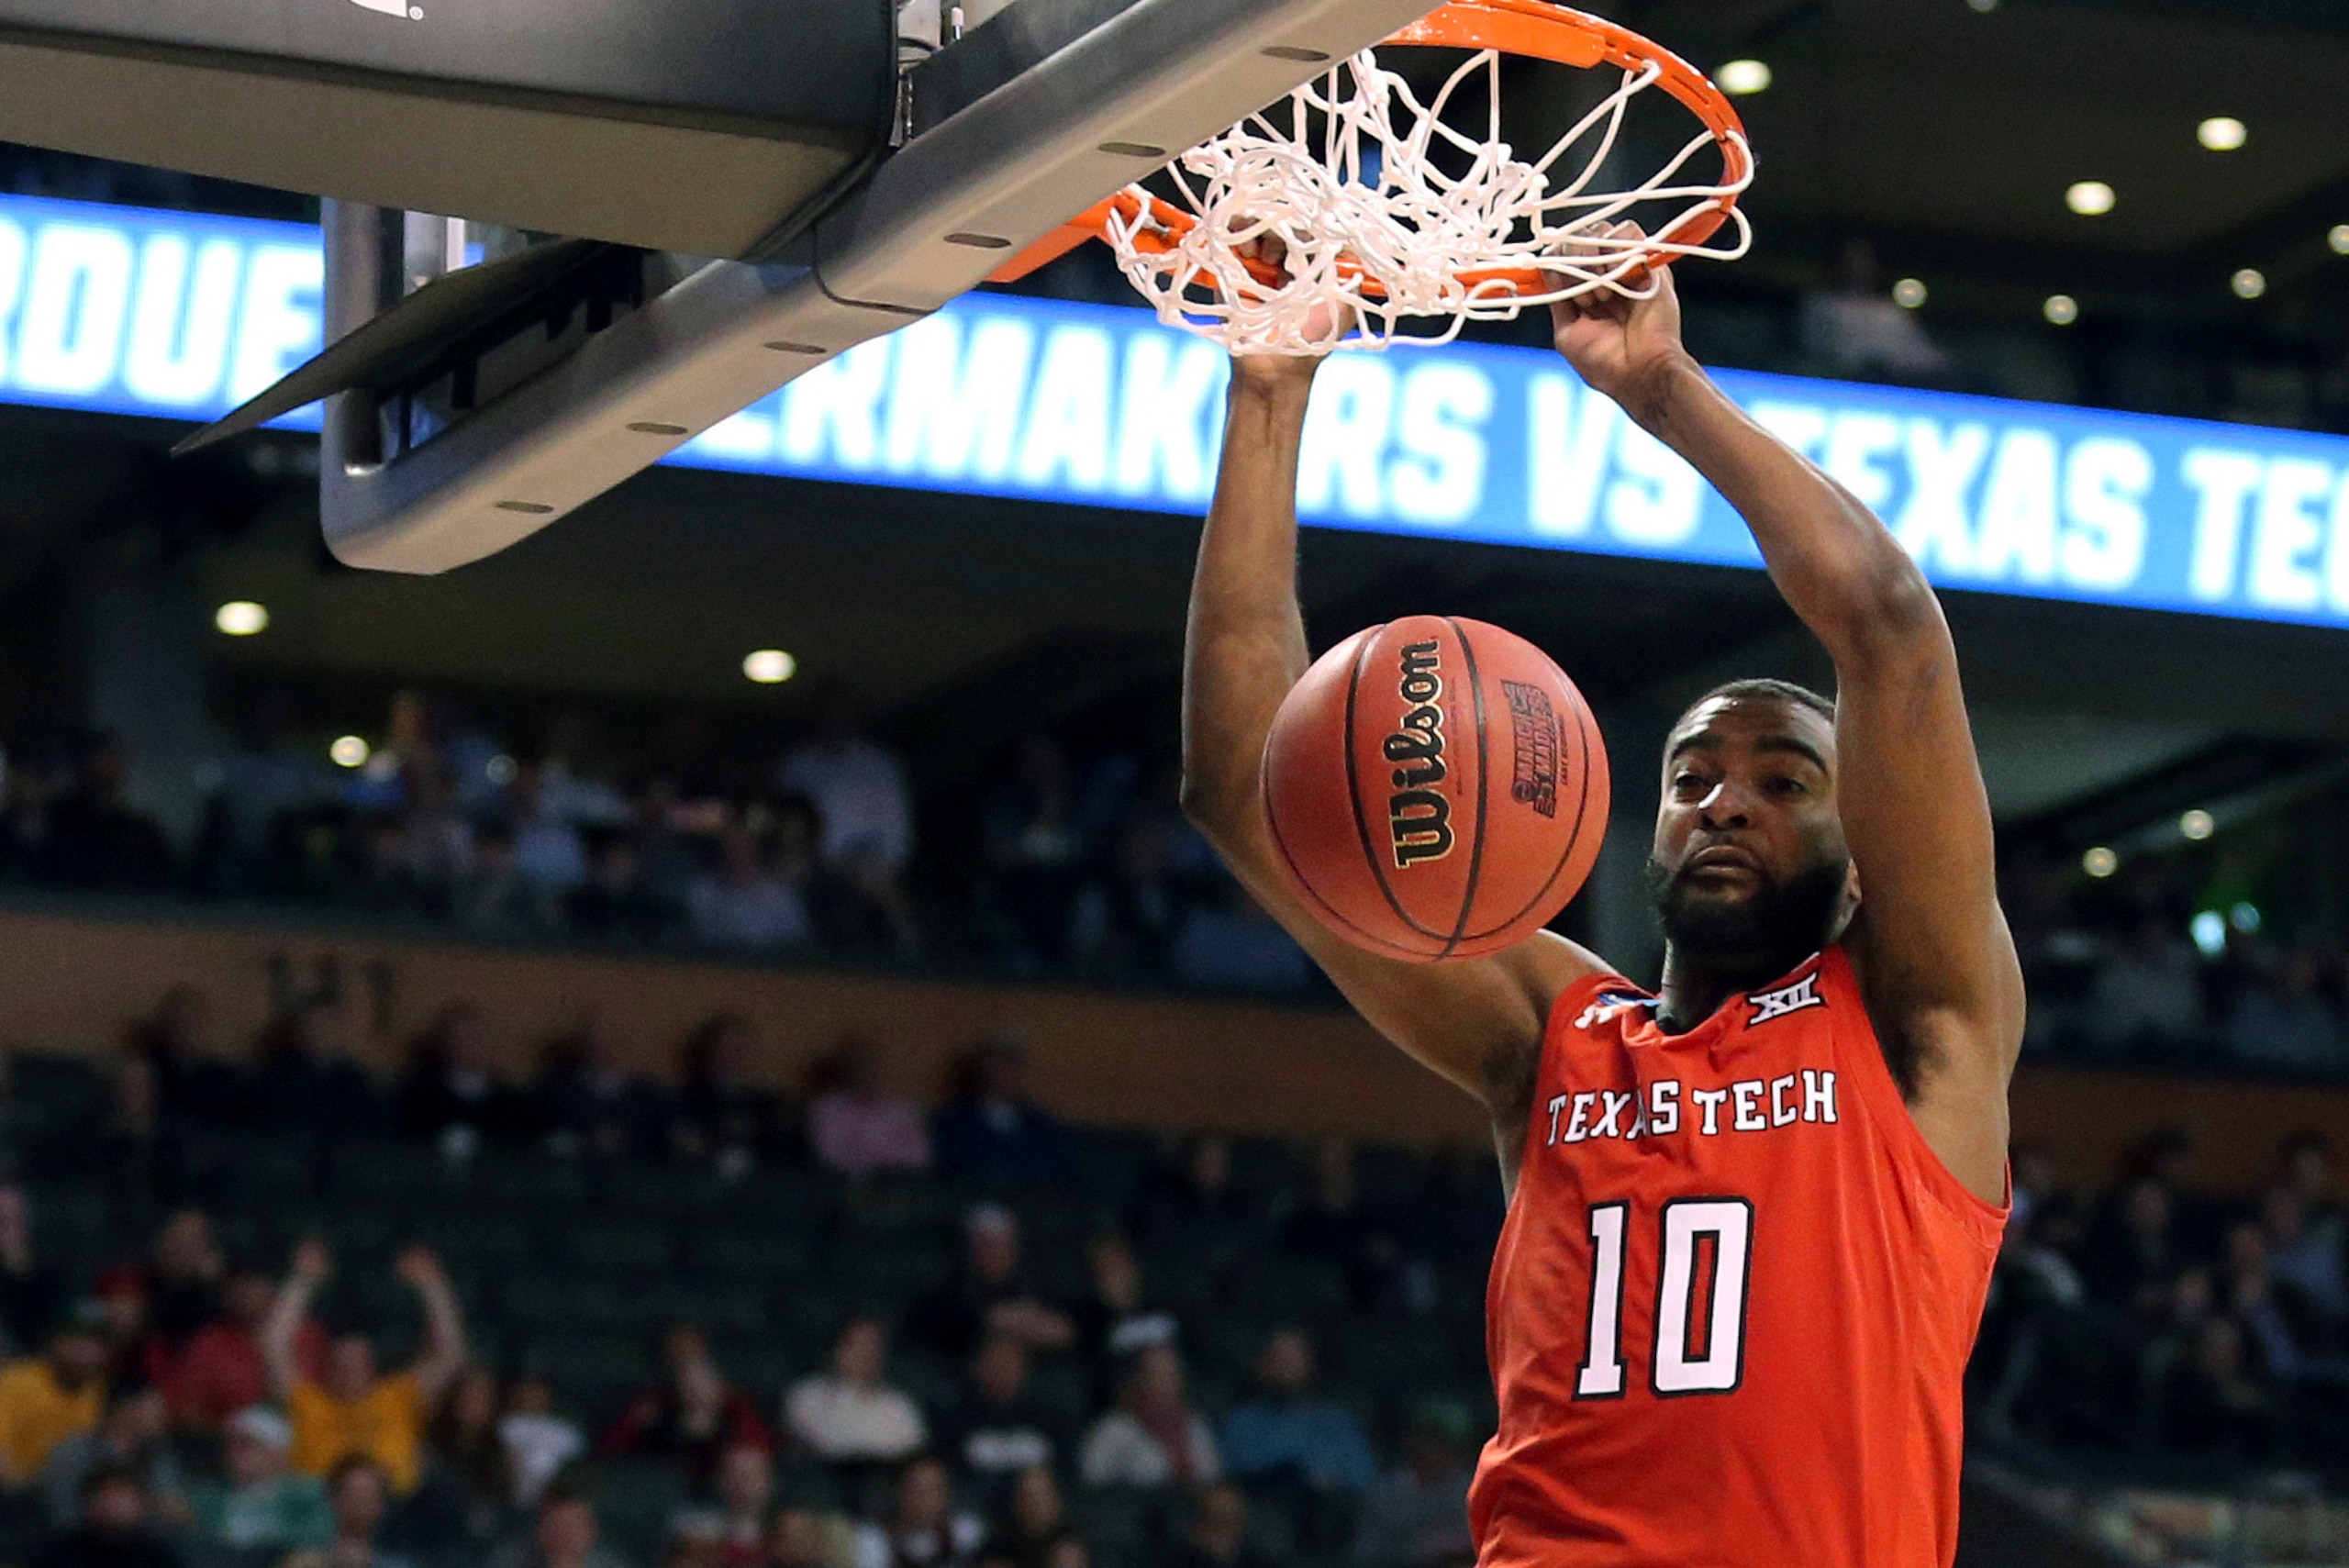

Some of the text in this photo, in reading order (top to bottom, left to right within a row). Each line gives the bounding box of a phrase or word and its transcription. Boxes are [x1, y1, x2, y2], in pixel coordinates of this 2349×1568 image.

[677, 314, 1496, 528] RMAKRS
[1527, 372, 1705, 549] VS
[2180, 447, 2349, 613] TE
[1383, 639, 1455, 870] Wilson
[1547, 1069, 1838, 1148] TEXAS TECH
[1575, 1196, 1753, 1398] 10
